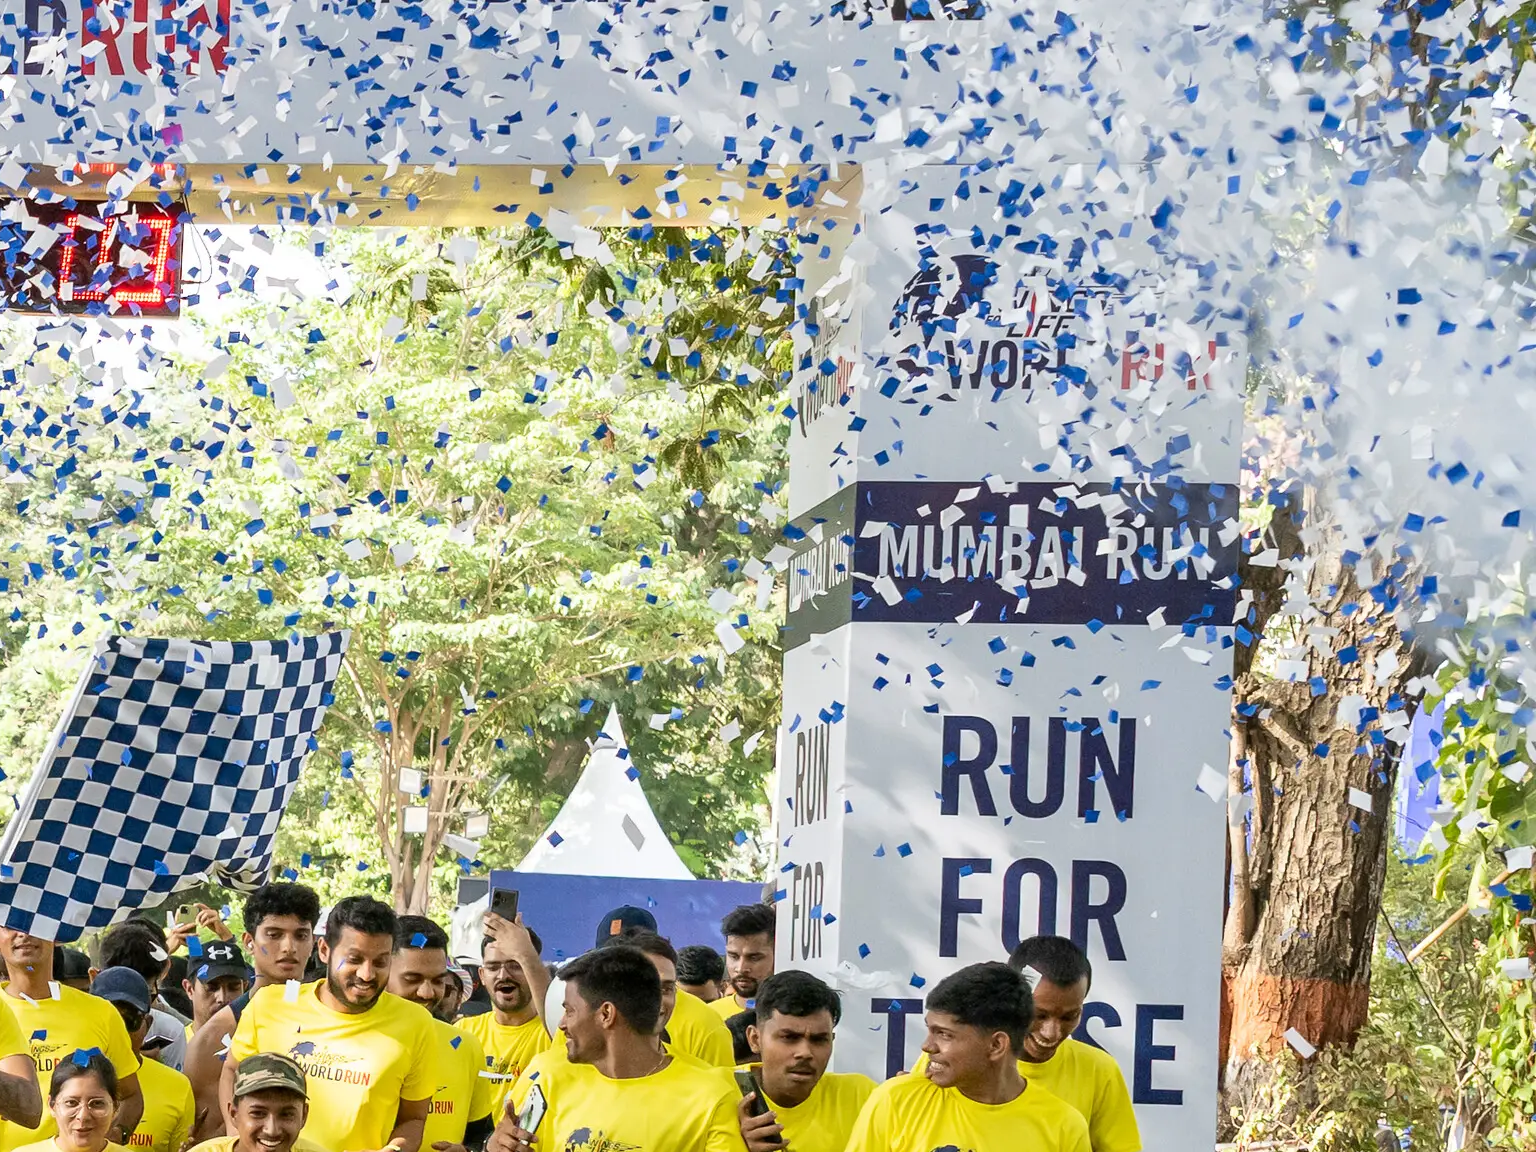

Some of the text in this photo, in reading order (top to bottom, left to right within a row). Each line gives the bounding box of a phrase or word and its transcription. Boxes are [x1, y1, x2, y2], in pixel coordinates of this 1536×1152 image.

[81, 0, 232, 76] RUN
[878, 524, 1210, 582] MUMBAI RUN
[794, 723, 829, 828] RUN
[940, 715, 1136, 819] RUN
[790, 860, 824, 962] FOR
[939, 857, 1127, 962] FOR
[344, 1070, 371, 1086] RUN
[435, 1101, 454, 1114] RUN
[130, 1133, 153, 1147] RUN
